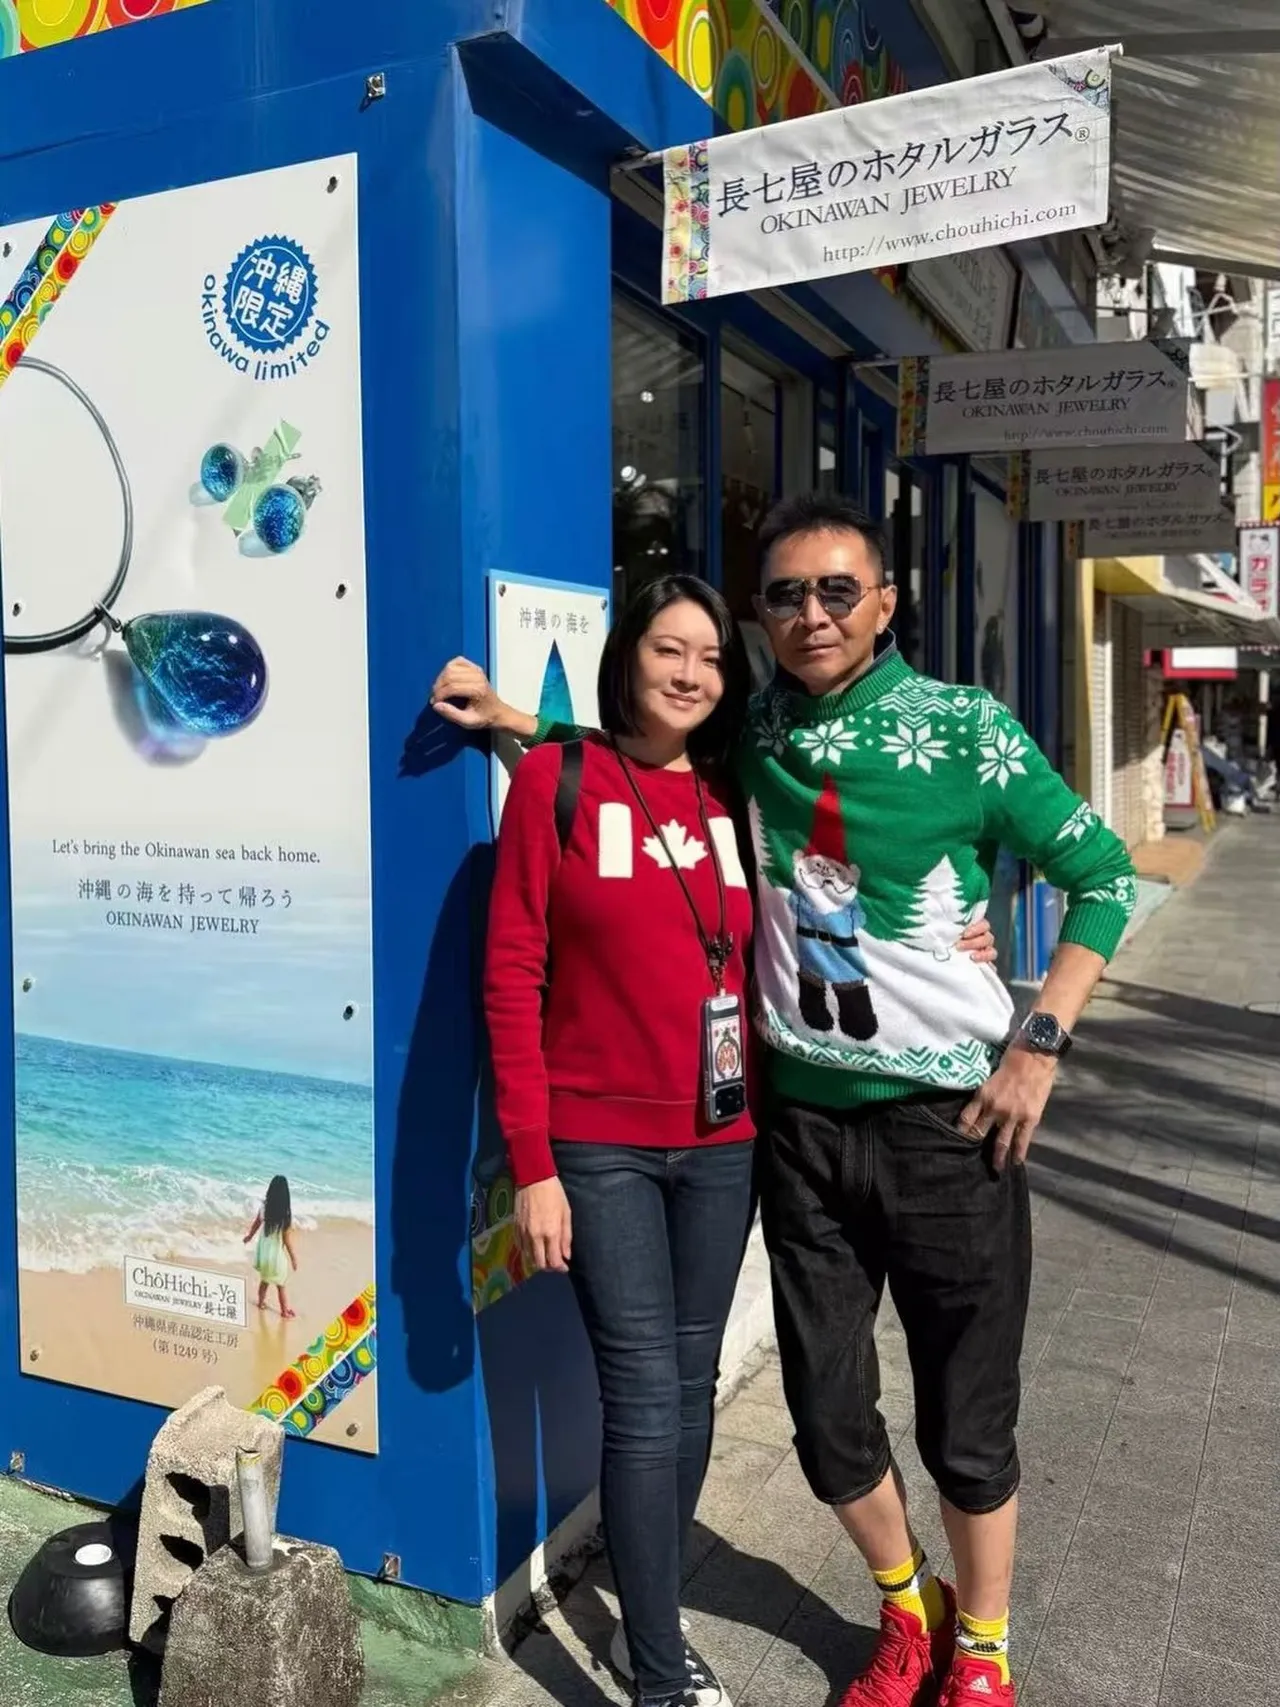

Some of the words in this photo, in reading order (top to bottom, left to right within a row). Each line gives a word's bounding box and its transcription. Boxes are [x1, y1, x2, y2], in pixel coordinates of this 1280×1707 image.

[760, 192, 890, 236] OKINAWAN
[900, 166, 1017, 215] JEWELRY
[822, 203, 1077, 264] http://www.chouhichi.com
[243, 248, 308, 305] 沖縄
[201, 274, 250, 373] okinawa
[254, 319, 331, 380] limited
[230, 285, 295, 343] 限定
[961, 400, 1050, 419] OKINAWAN
[1058, 397, 1132, 416] JEWELRY
[52, 839, 79, 854] Let's
[83, 841, 116, 859] bring
[120, 842, 140, 857] the
[145, 842, 210, 859] Okinawan
[215, 848, 236, 860] sea
[241, 845, 273, 861] back
[278, 846, 320, 864] home.
[106, 911, 183, 929] OKINAWAN
[189, 916, 259, 934] JEWELRY
